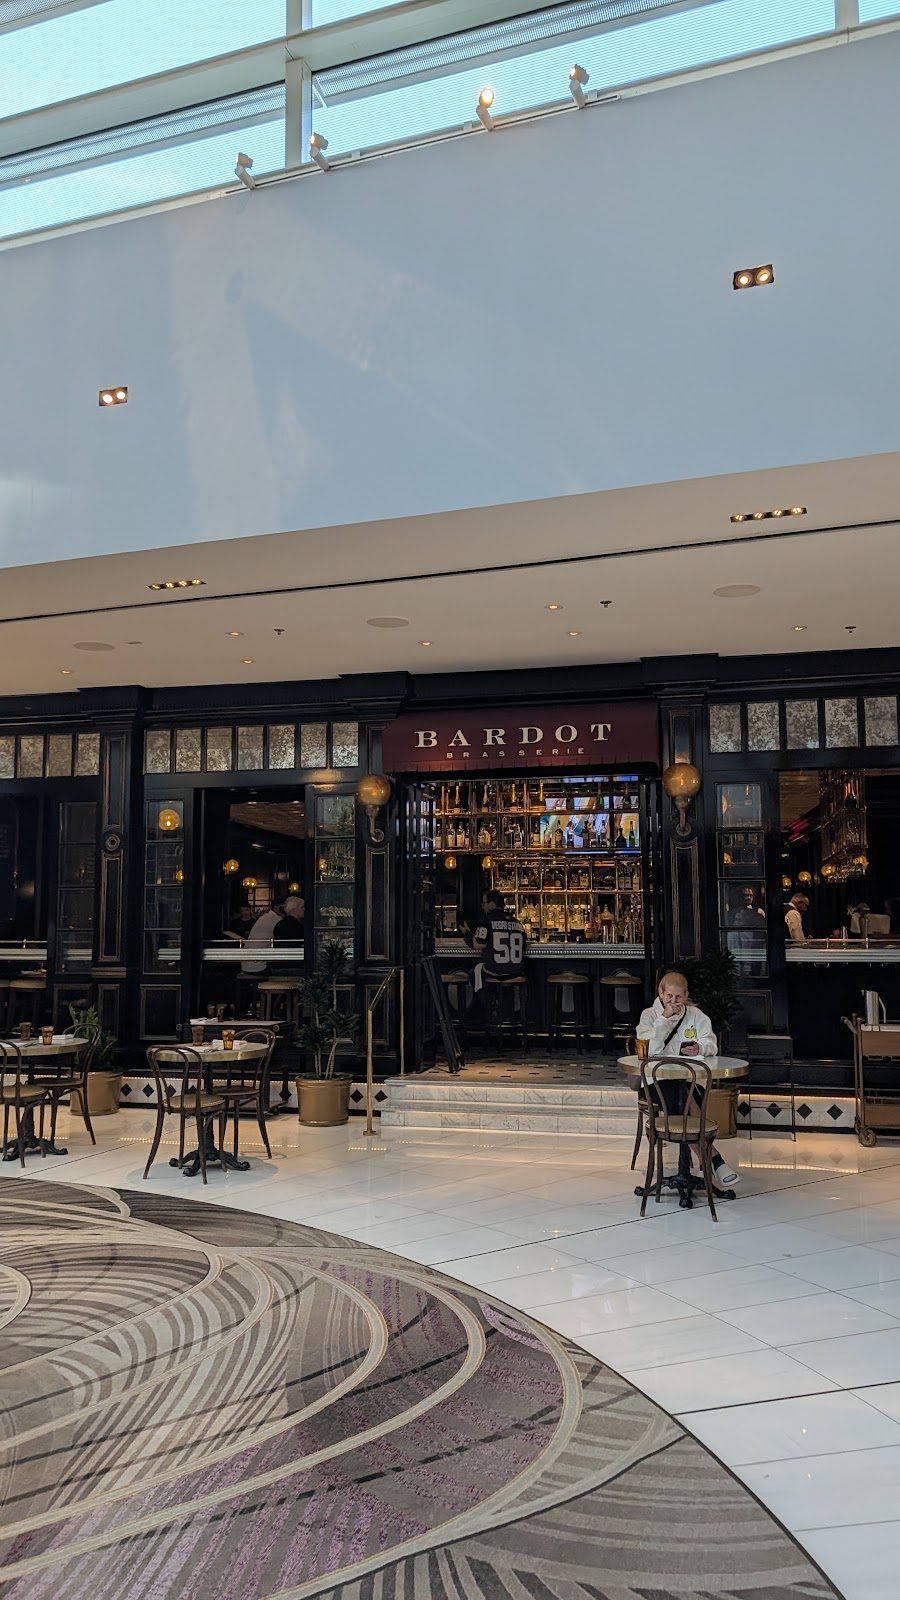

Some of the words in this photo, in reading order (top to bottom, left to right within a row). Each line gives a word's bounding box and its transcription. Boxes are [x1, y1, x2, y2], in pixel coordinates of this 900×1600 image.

[414, 723, 612, 748] BARDOT
[446, 748, 584, 759] BRASSERIE
[492, 932, 524, 964] 58
